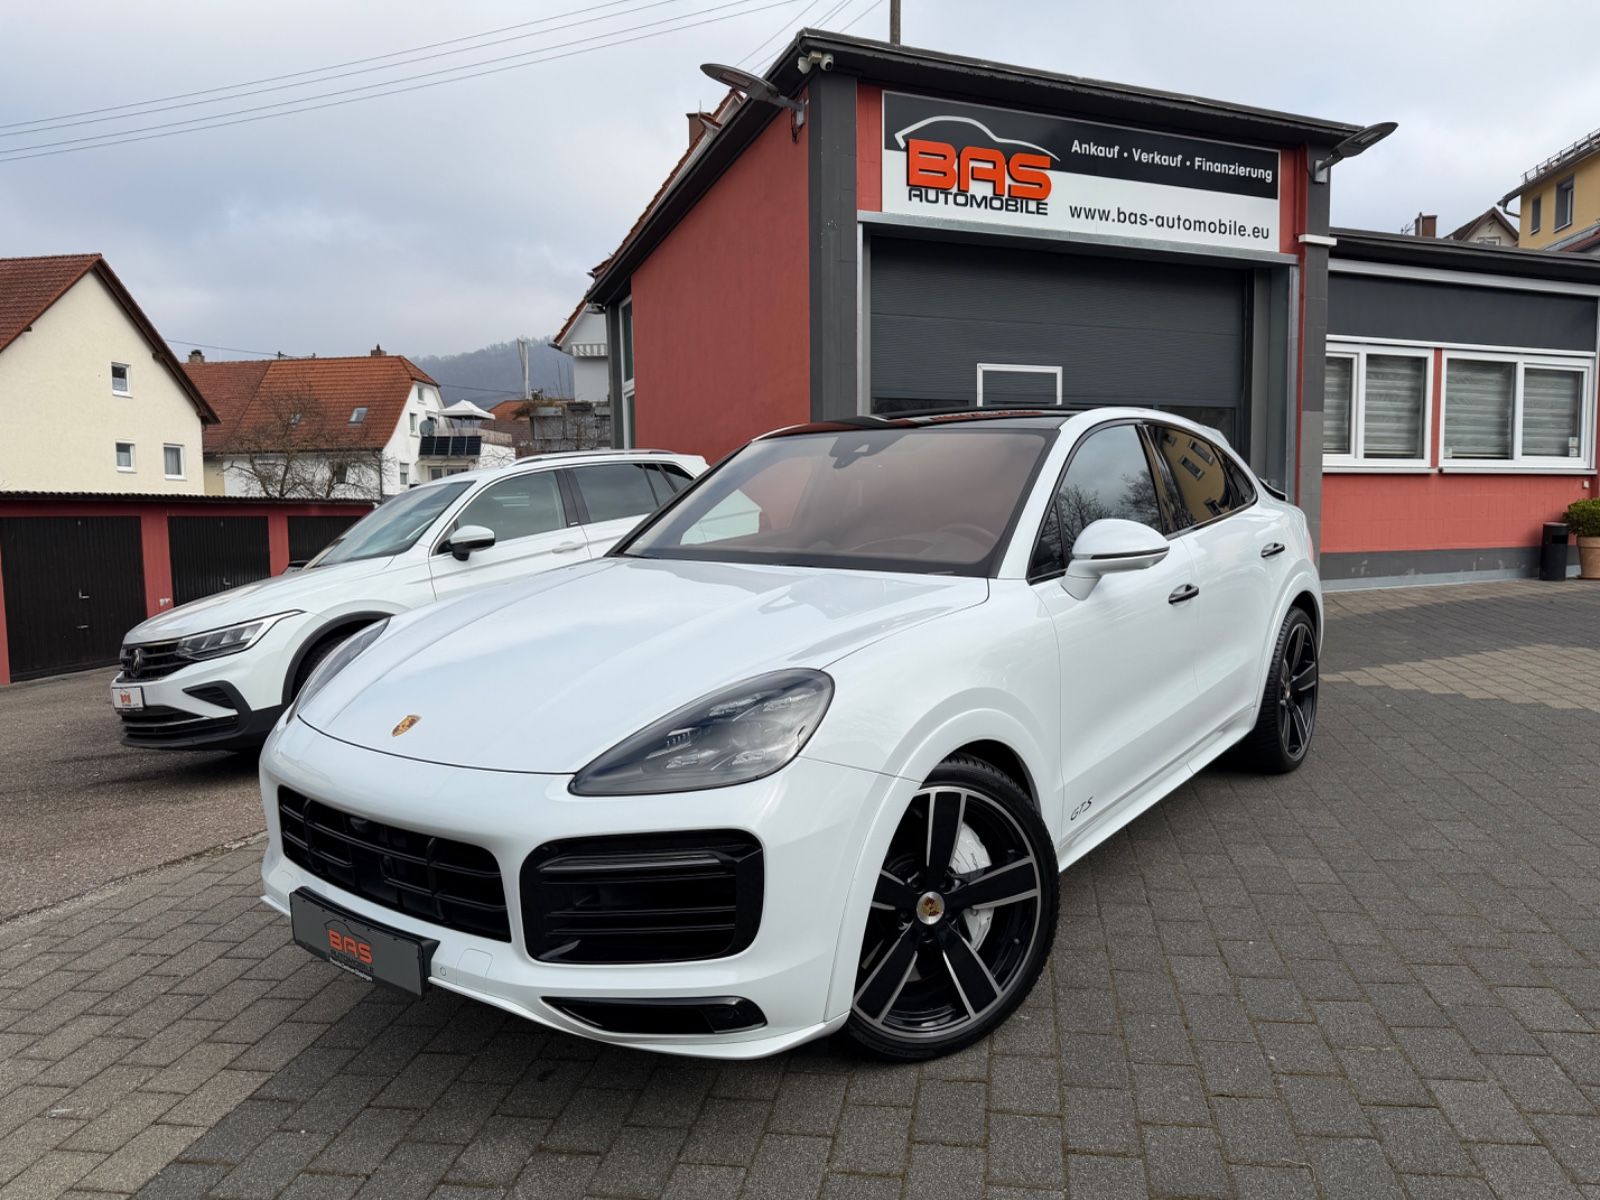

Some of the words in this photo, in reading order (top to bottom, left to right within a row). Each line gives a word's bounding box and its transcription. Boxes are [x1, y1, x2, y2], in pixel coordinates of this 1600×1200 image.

[907, 138, 1052, 201] BAS
[1071, 139, 1120, 159] Ankauf
[1132, 148, 1183, 168] Verkauf
[1194, 157, 1273, 183] Finanzierung
[908, 187, 1049, 216] AUTOMOBILE
[1069, 204, 1270, 240] www.bas-automobile.eu
[1070, 796, 1093, 821] GTS
[328, 928, 373, 965] BAS
